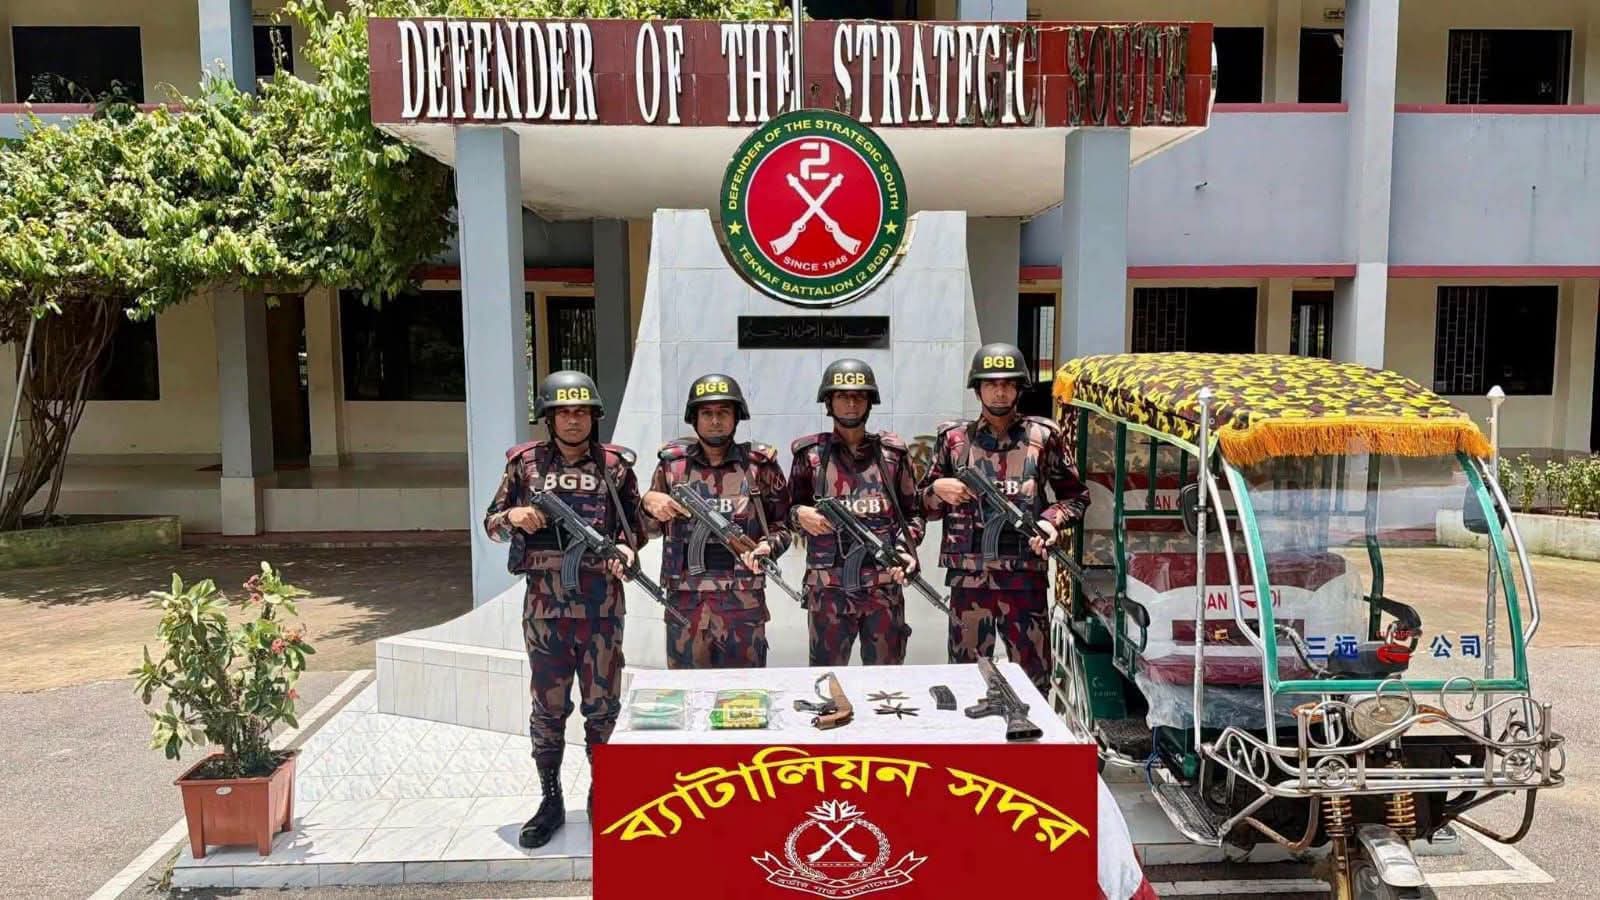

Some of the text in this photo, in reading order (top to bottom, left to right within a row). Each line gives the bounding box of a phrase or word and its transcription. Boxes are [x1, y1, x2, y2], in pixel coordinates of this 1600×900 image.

[397, 20, 1189, 125] DEFENDER OF THE STRATEGIC SOUTH
[728, 119, 899, 210] DEFENDER OF THE STRATEGIC SOUTH
[800, 142, 830, 180] 2
[739, 243, 893, 296] TEKNAF BATTALION (2 BGB)
[783, 255, 818, 272] SINCE
[982, 355, 1015, 369] BGB
[833, 372, 866, 385] BGB
[556, 387, 590, 401] BGB
[695, 381, 728, 396] BGB
[543, 472, 598, 491] BGB
[993, 479, 1018, 495] GB
[705, 498, 732, 513] GB
[1306, 634, 1482, 661] 三远 公司
[600, 746, 1090, 852] ব্যাটালিয়ন সদর
